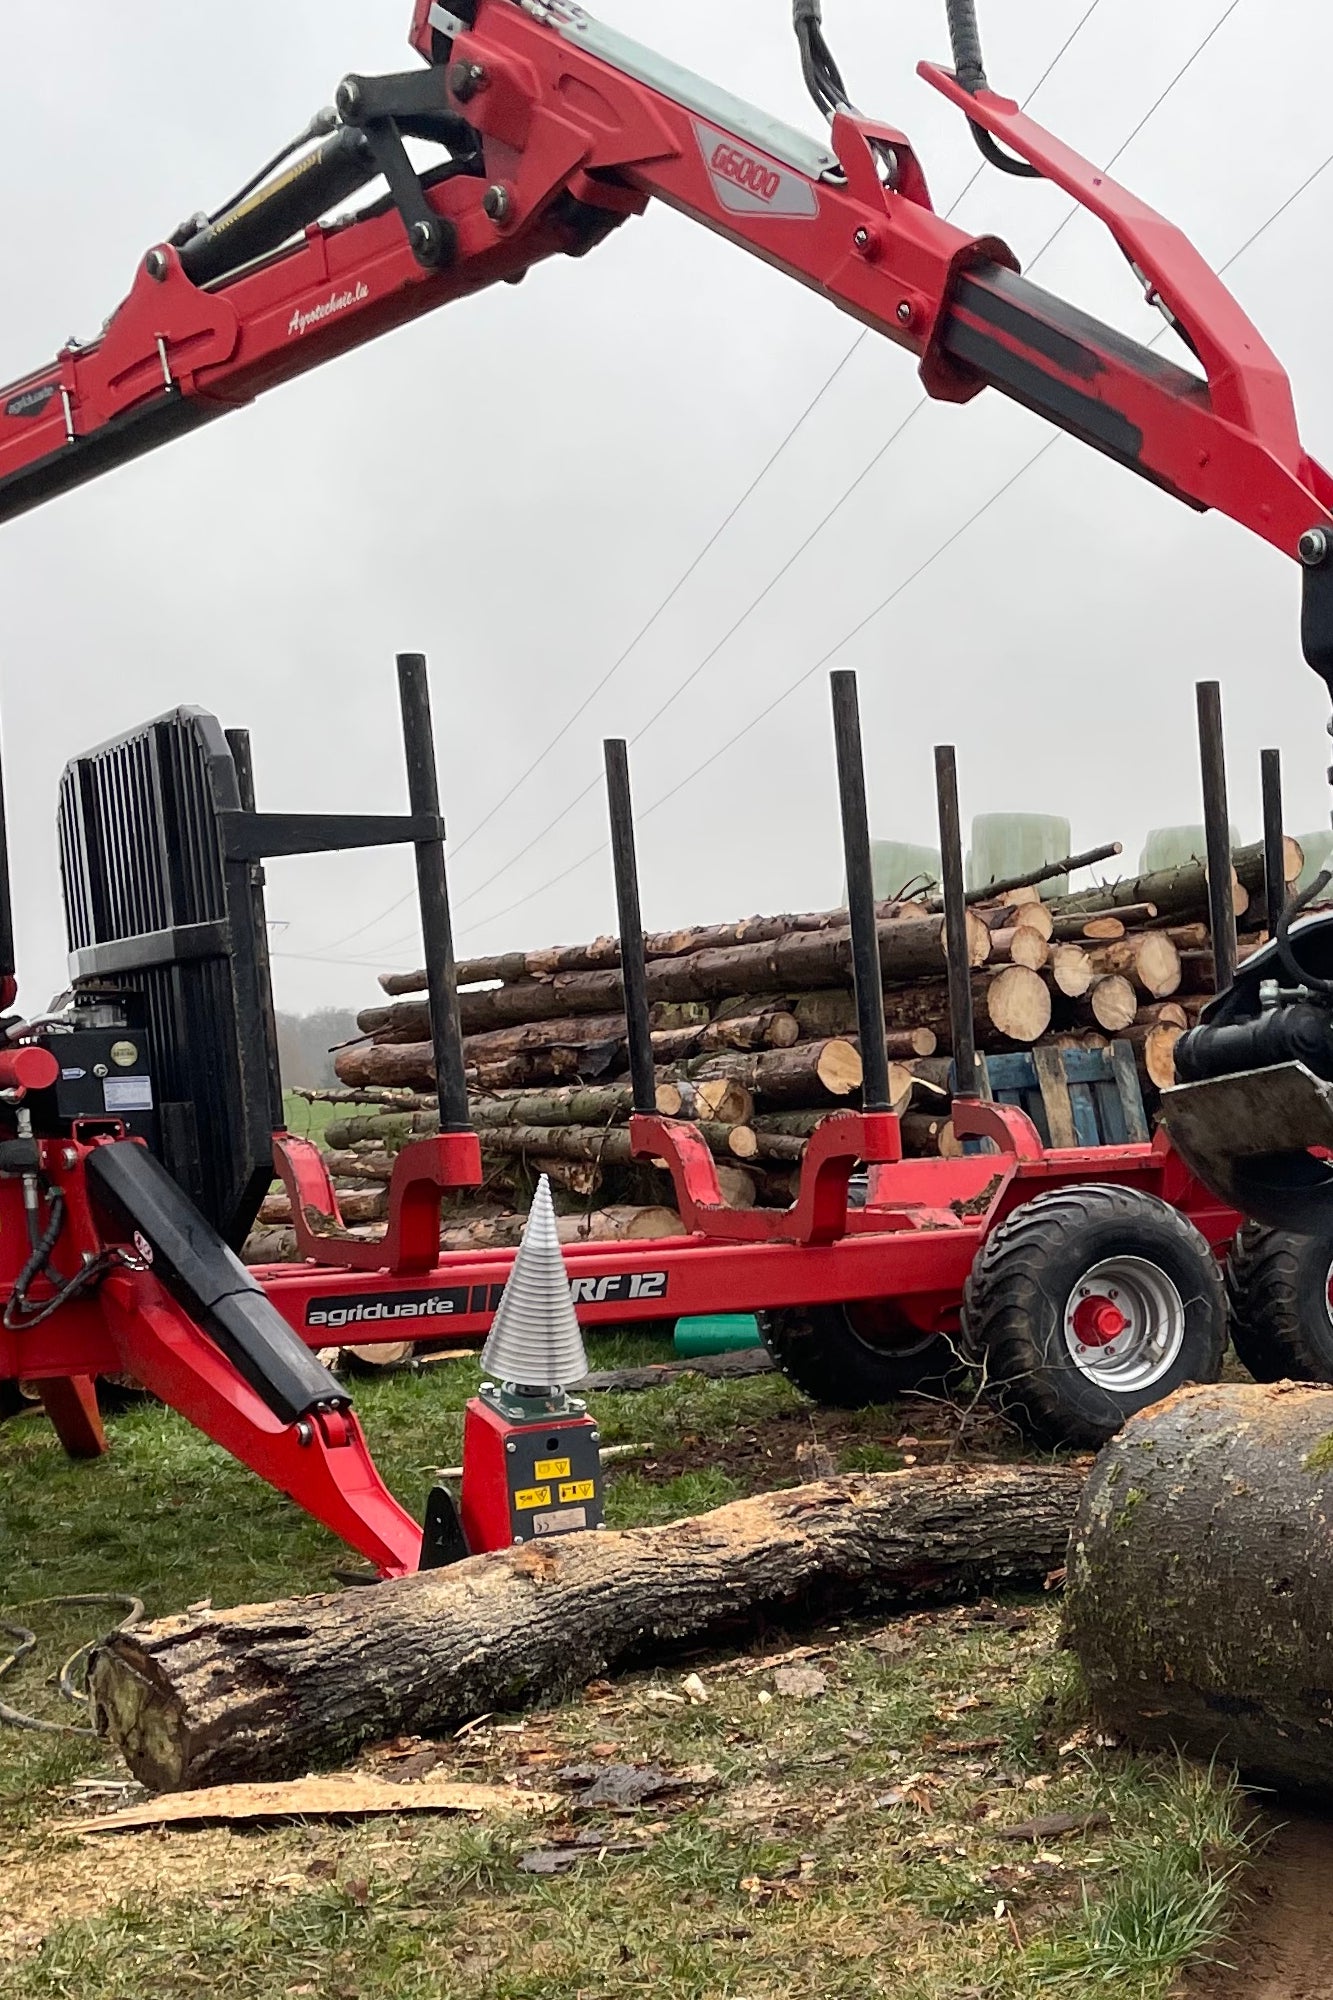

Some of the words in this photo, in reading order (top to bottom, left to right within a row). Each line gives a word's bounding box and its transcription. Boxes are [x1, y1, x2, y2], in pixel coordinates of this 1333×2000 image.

[711, 143, 780, 199] G6000
[287, 281, 369, 335] Agrotechnic.lu
[628, 1272, 666, 1298] 12
[308, 1296, 454, 1327] agriduarte
